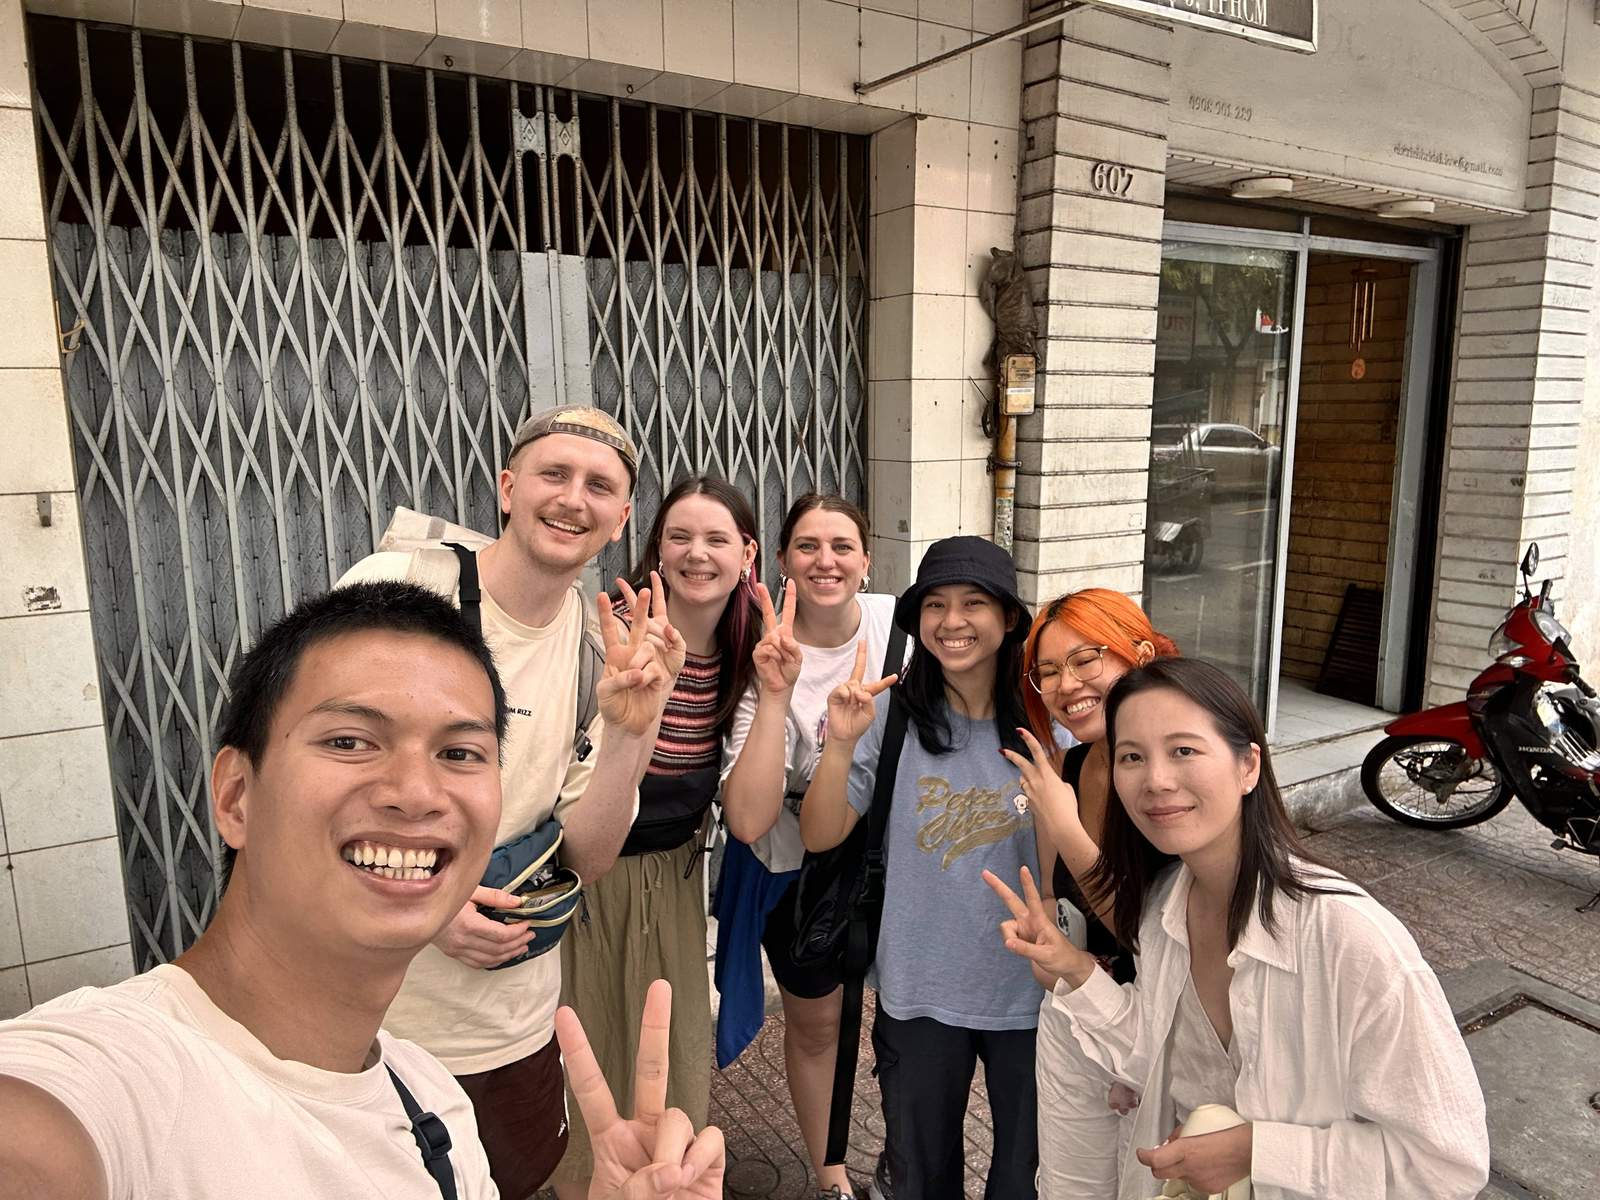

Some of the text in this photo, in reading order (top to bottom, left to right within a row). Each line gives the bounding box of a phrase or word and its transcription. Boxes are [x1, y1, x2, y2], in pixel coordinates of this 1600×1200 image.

[1091, 162, 1133, 197] 607
[517, 708, 532, 716] RIZZ
[1518, 746, 1554, 754] HONDA
